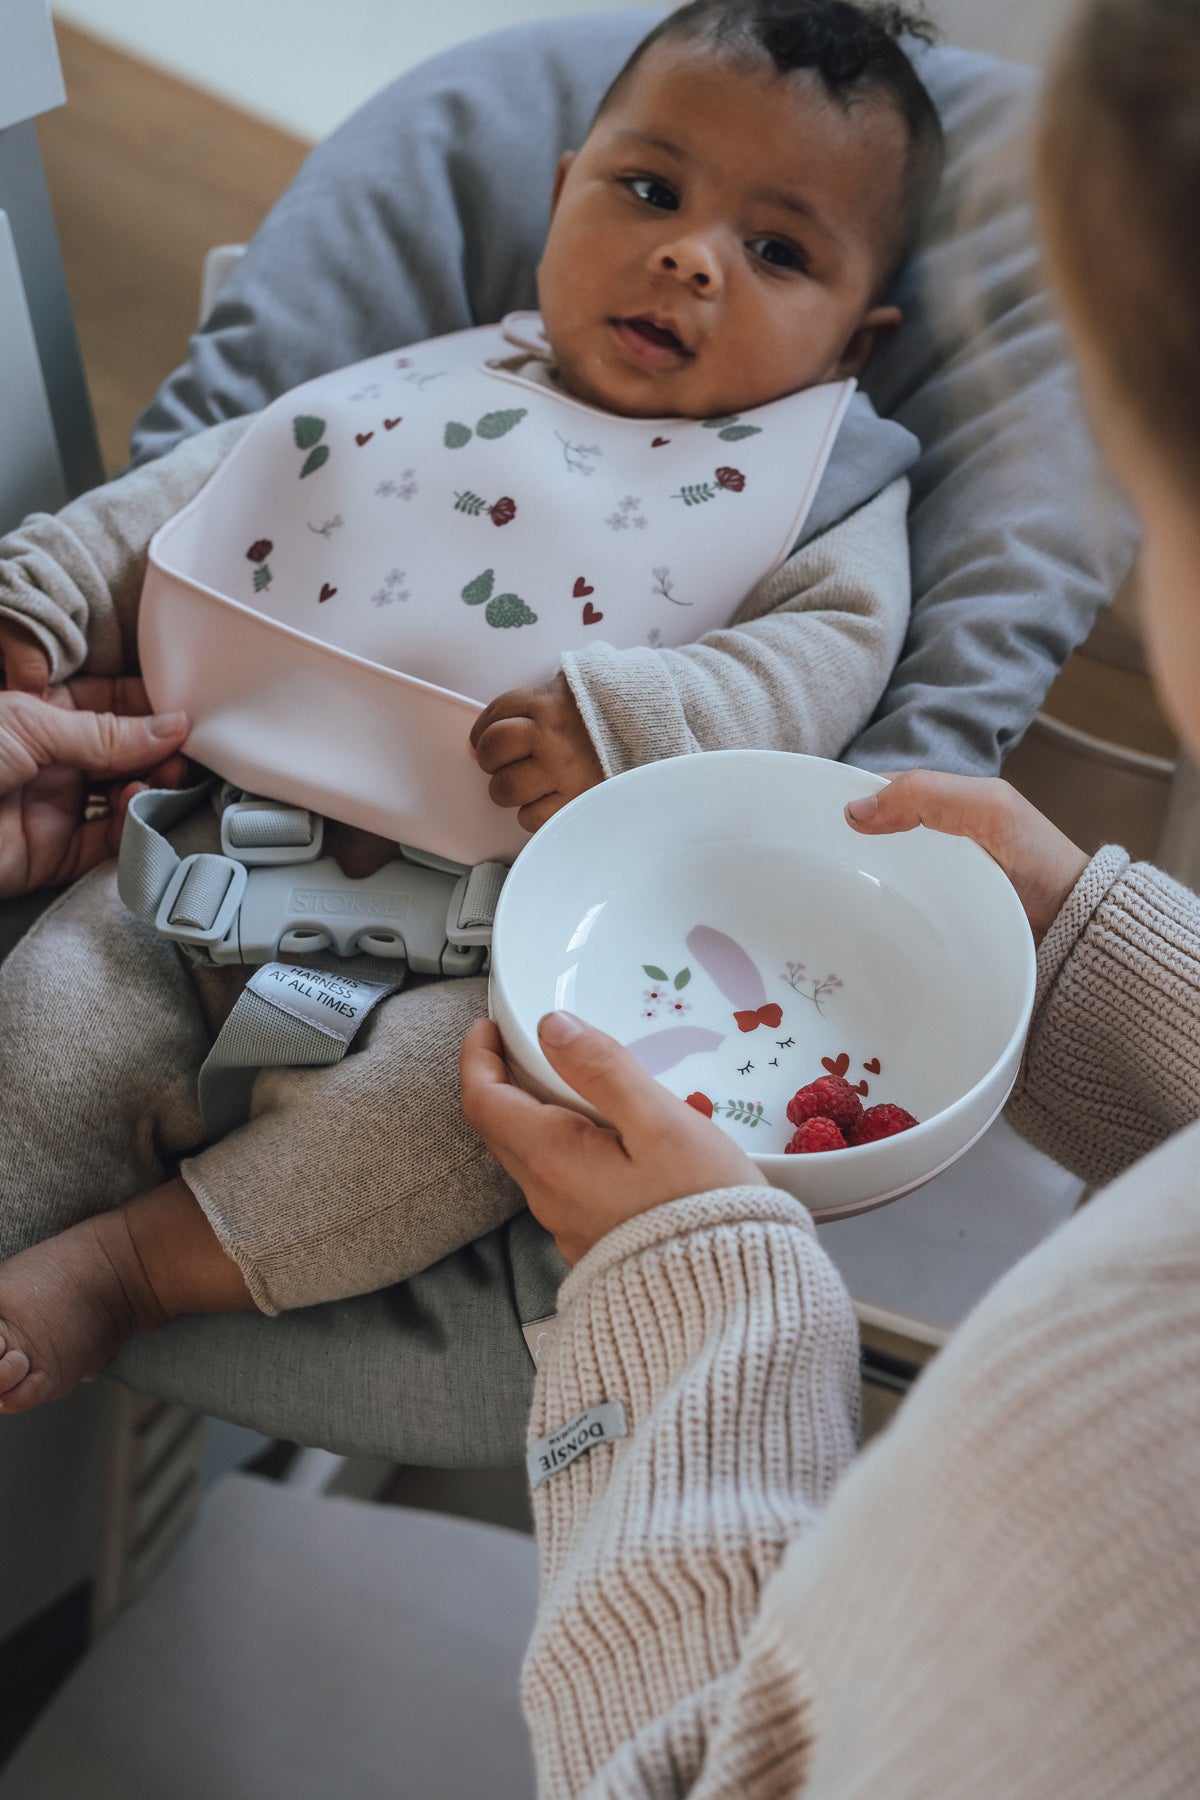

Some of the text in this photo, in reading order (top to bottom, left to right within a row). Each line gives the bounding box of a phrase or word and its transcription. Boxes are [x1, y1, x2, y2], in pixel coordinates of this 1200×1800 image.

[292, 893, 400, 917] STOKKE
[268, 970, 290, 983] AT
[287, 979, 312, 998] ALL
[316, 990, 358, 1018] TIMES
[290, 967, 354, 999] HARNESS
[539, 1421, 605, 1472] DONSJE
